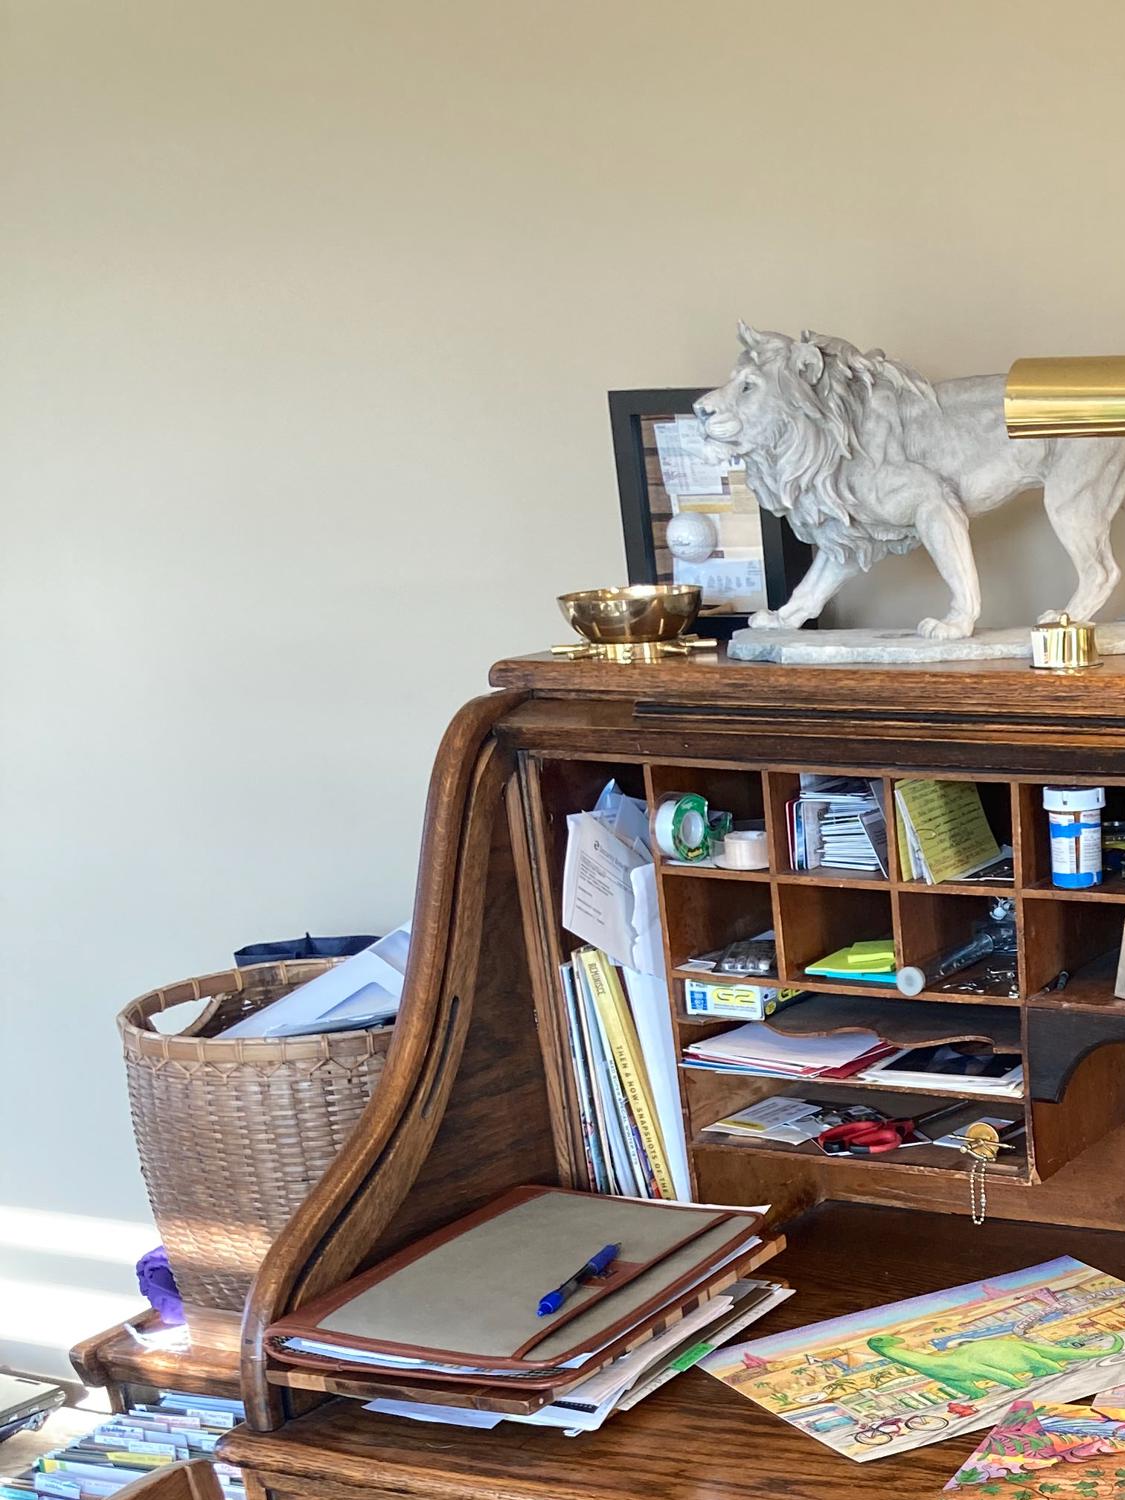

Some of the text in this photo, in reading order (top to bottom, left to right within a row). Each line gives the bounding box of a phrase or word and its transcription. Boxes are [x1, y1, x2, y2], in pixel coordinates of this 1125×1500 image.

[615, 1045, 629, 1070] THEN
[635, 1107, 658, 1161] SNAPSHOTS
[653, 1162, 663, 1176] OF
[658, 1175, 669, 1193] THE
